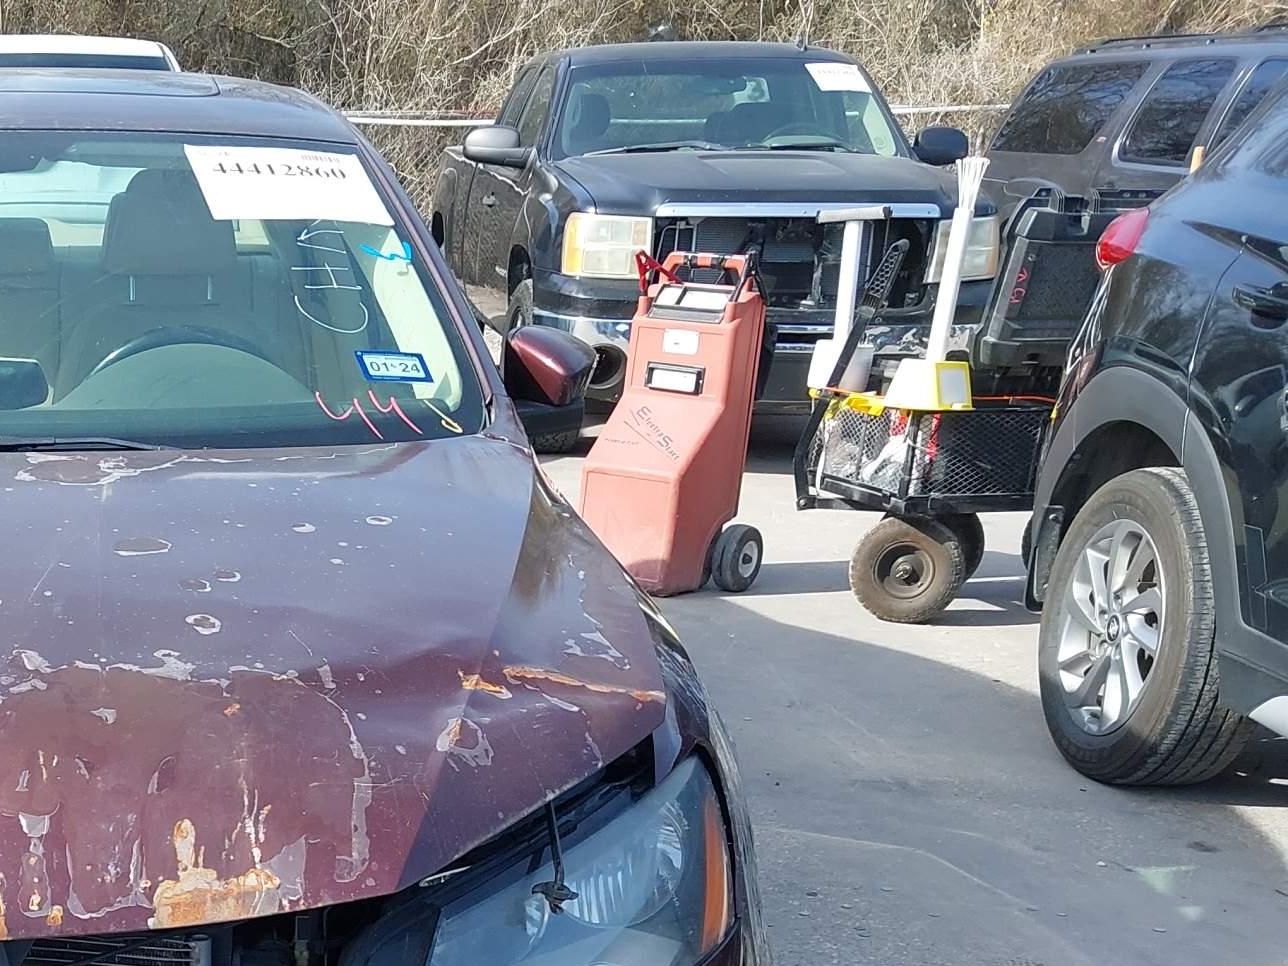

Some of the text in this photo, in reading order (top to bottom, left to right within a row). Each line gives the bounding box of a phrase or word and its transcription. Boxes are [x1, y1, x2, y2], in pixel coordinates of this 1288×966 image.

[212, 162, 348, 180] 44412860
[369, 361, 421, 374] 01 24
